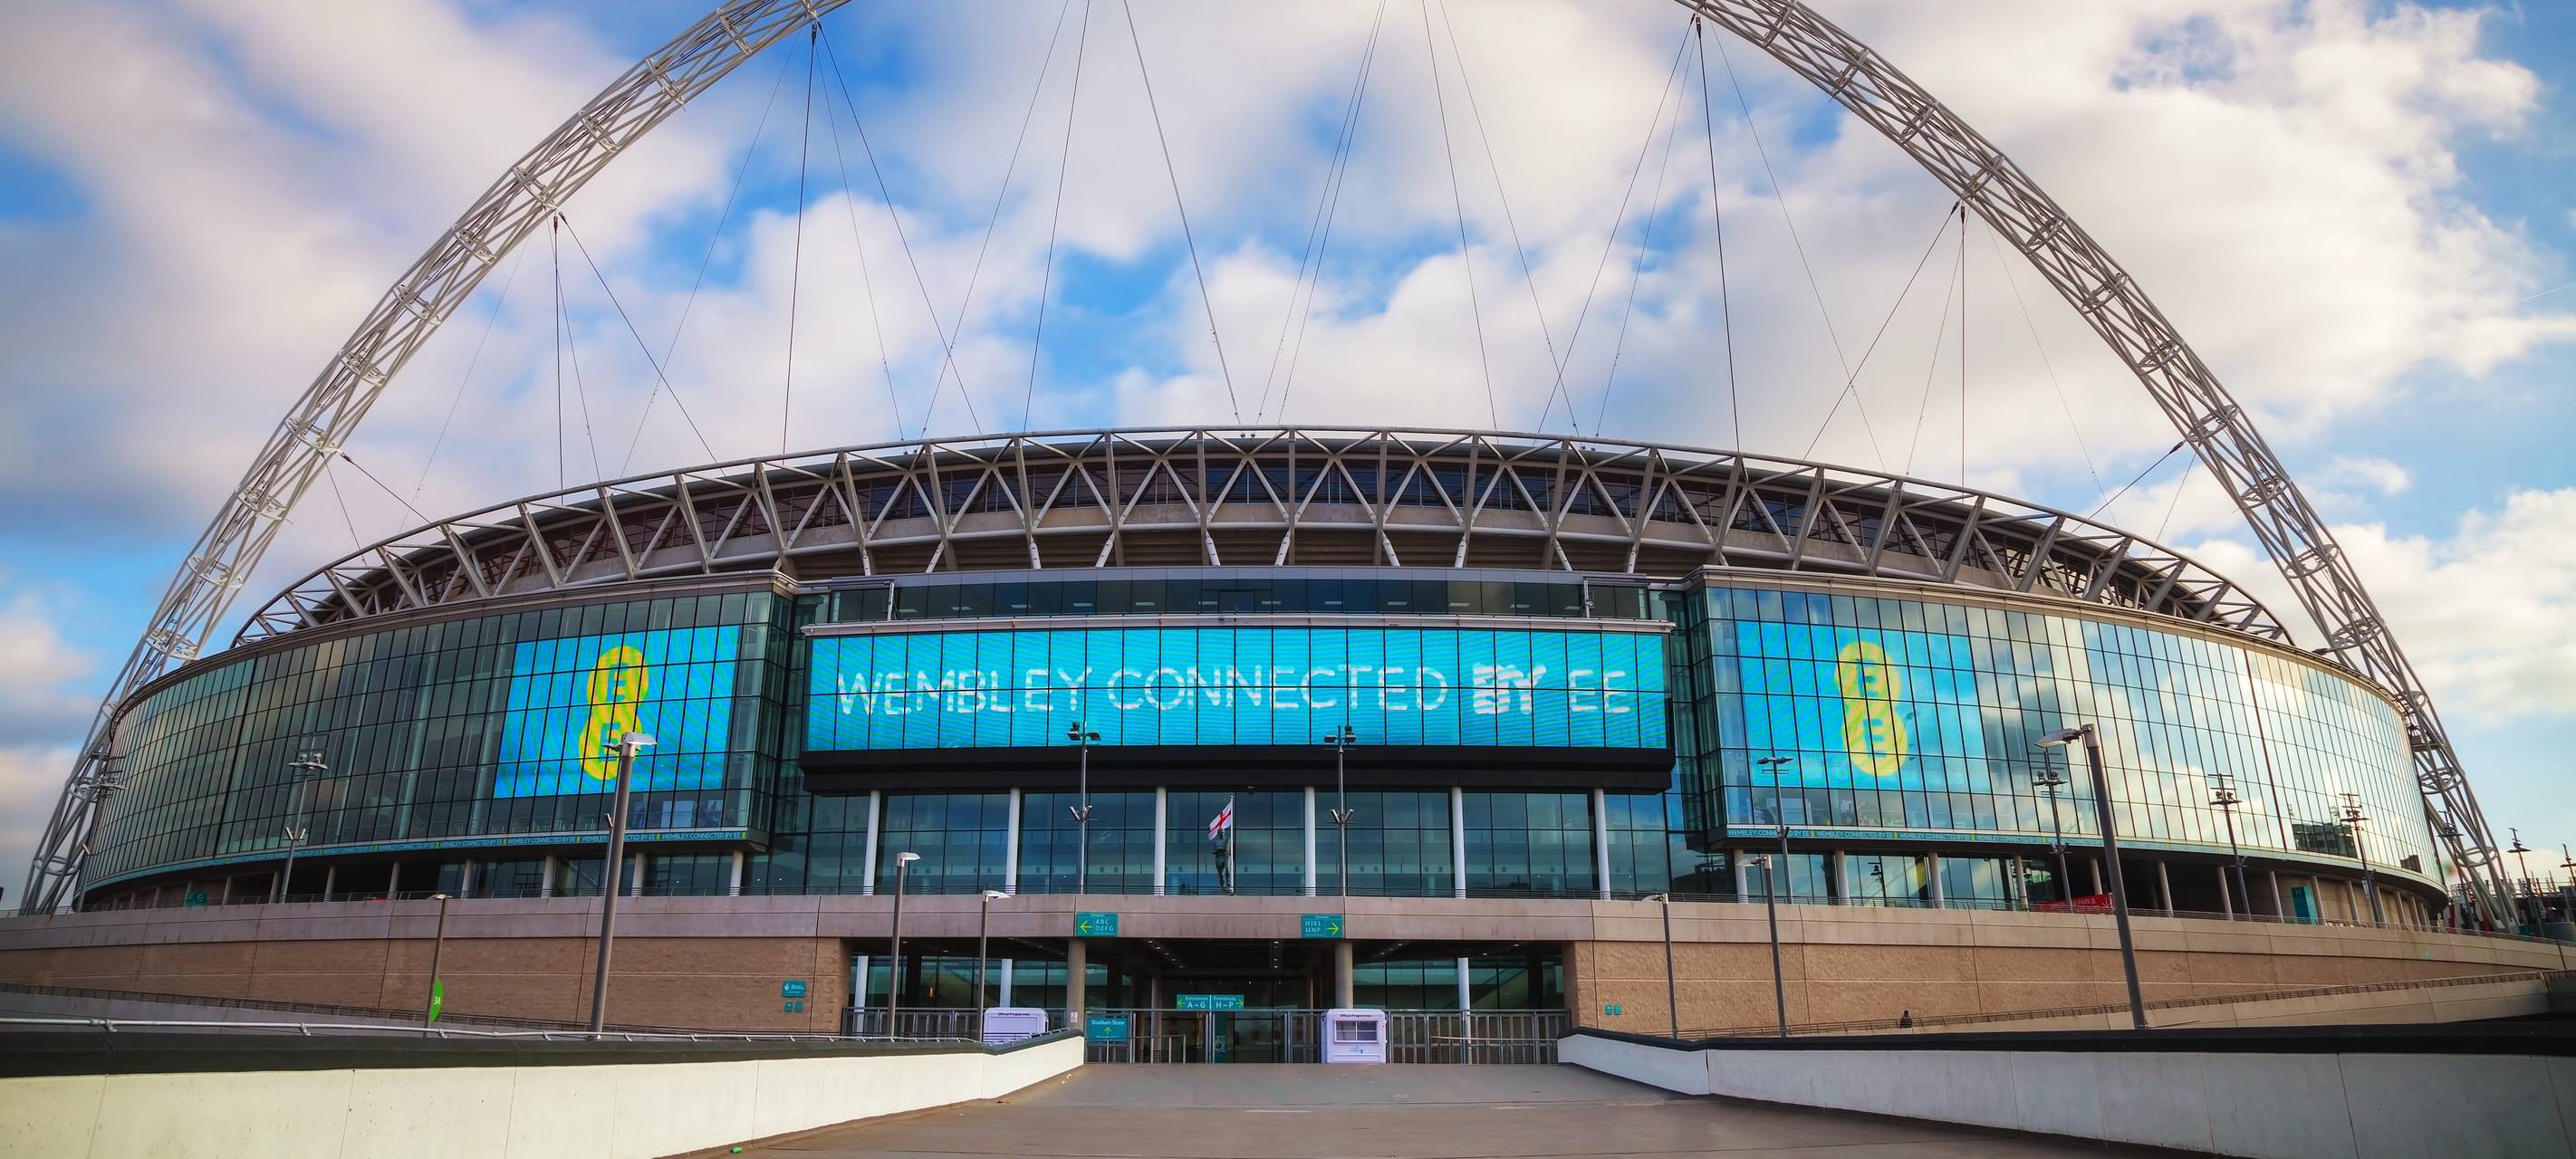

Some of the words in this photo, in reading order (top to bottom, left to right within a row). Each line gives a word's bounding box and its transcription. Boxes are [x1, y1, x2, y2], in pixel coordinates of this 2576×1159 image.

[837, 666, 1092, 715] WEMBLEY
[1107, 664, 1448, 712] CONNECTED
[1472, 662, 1547, 715] BY
[1569, 668, 1630, 714] EE
